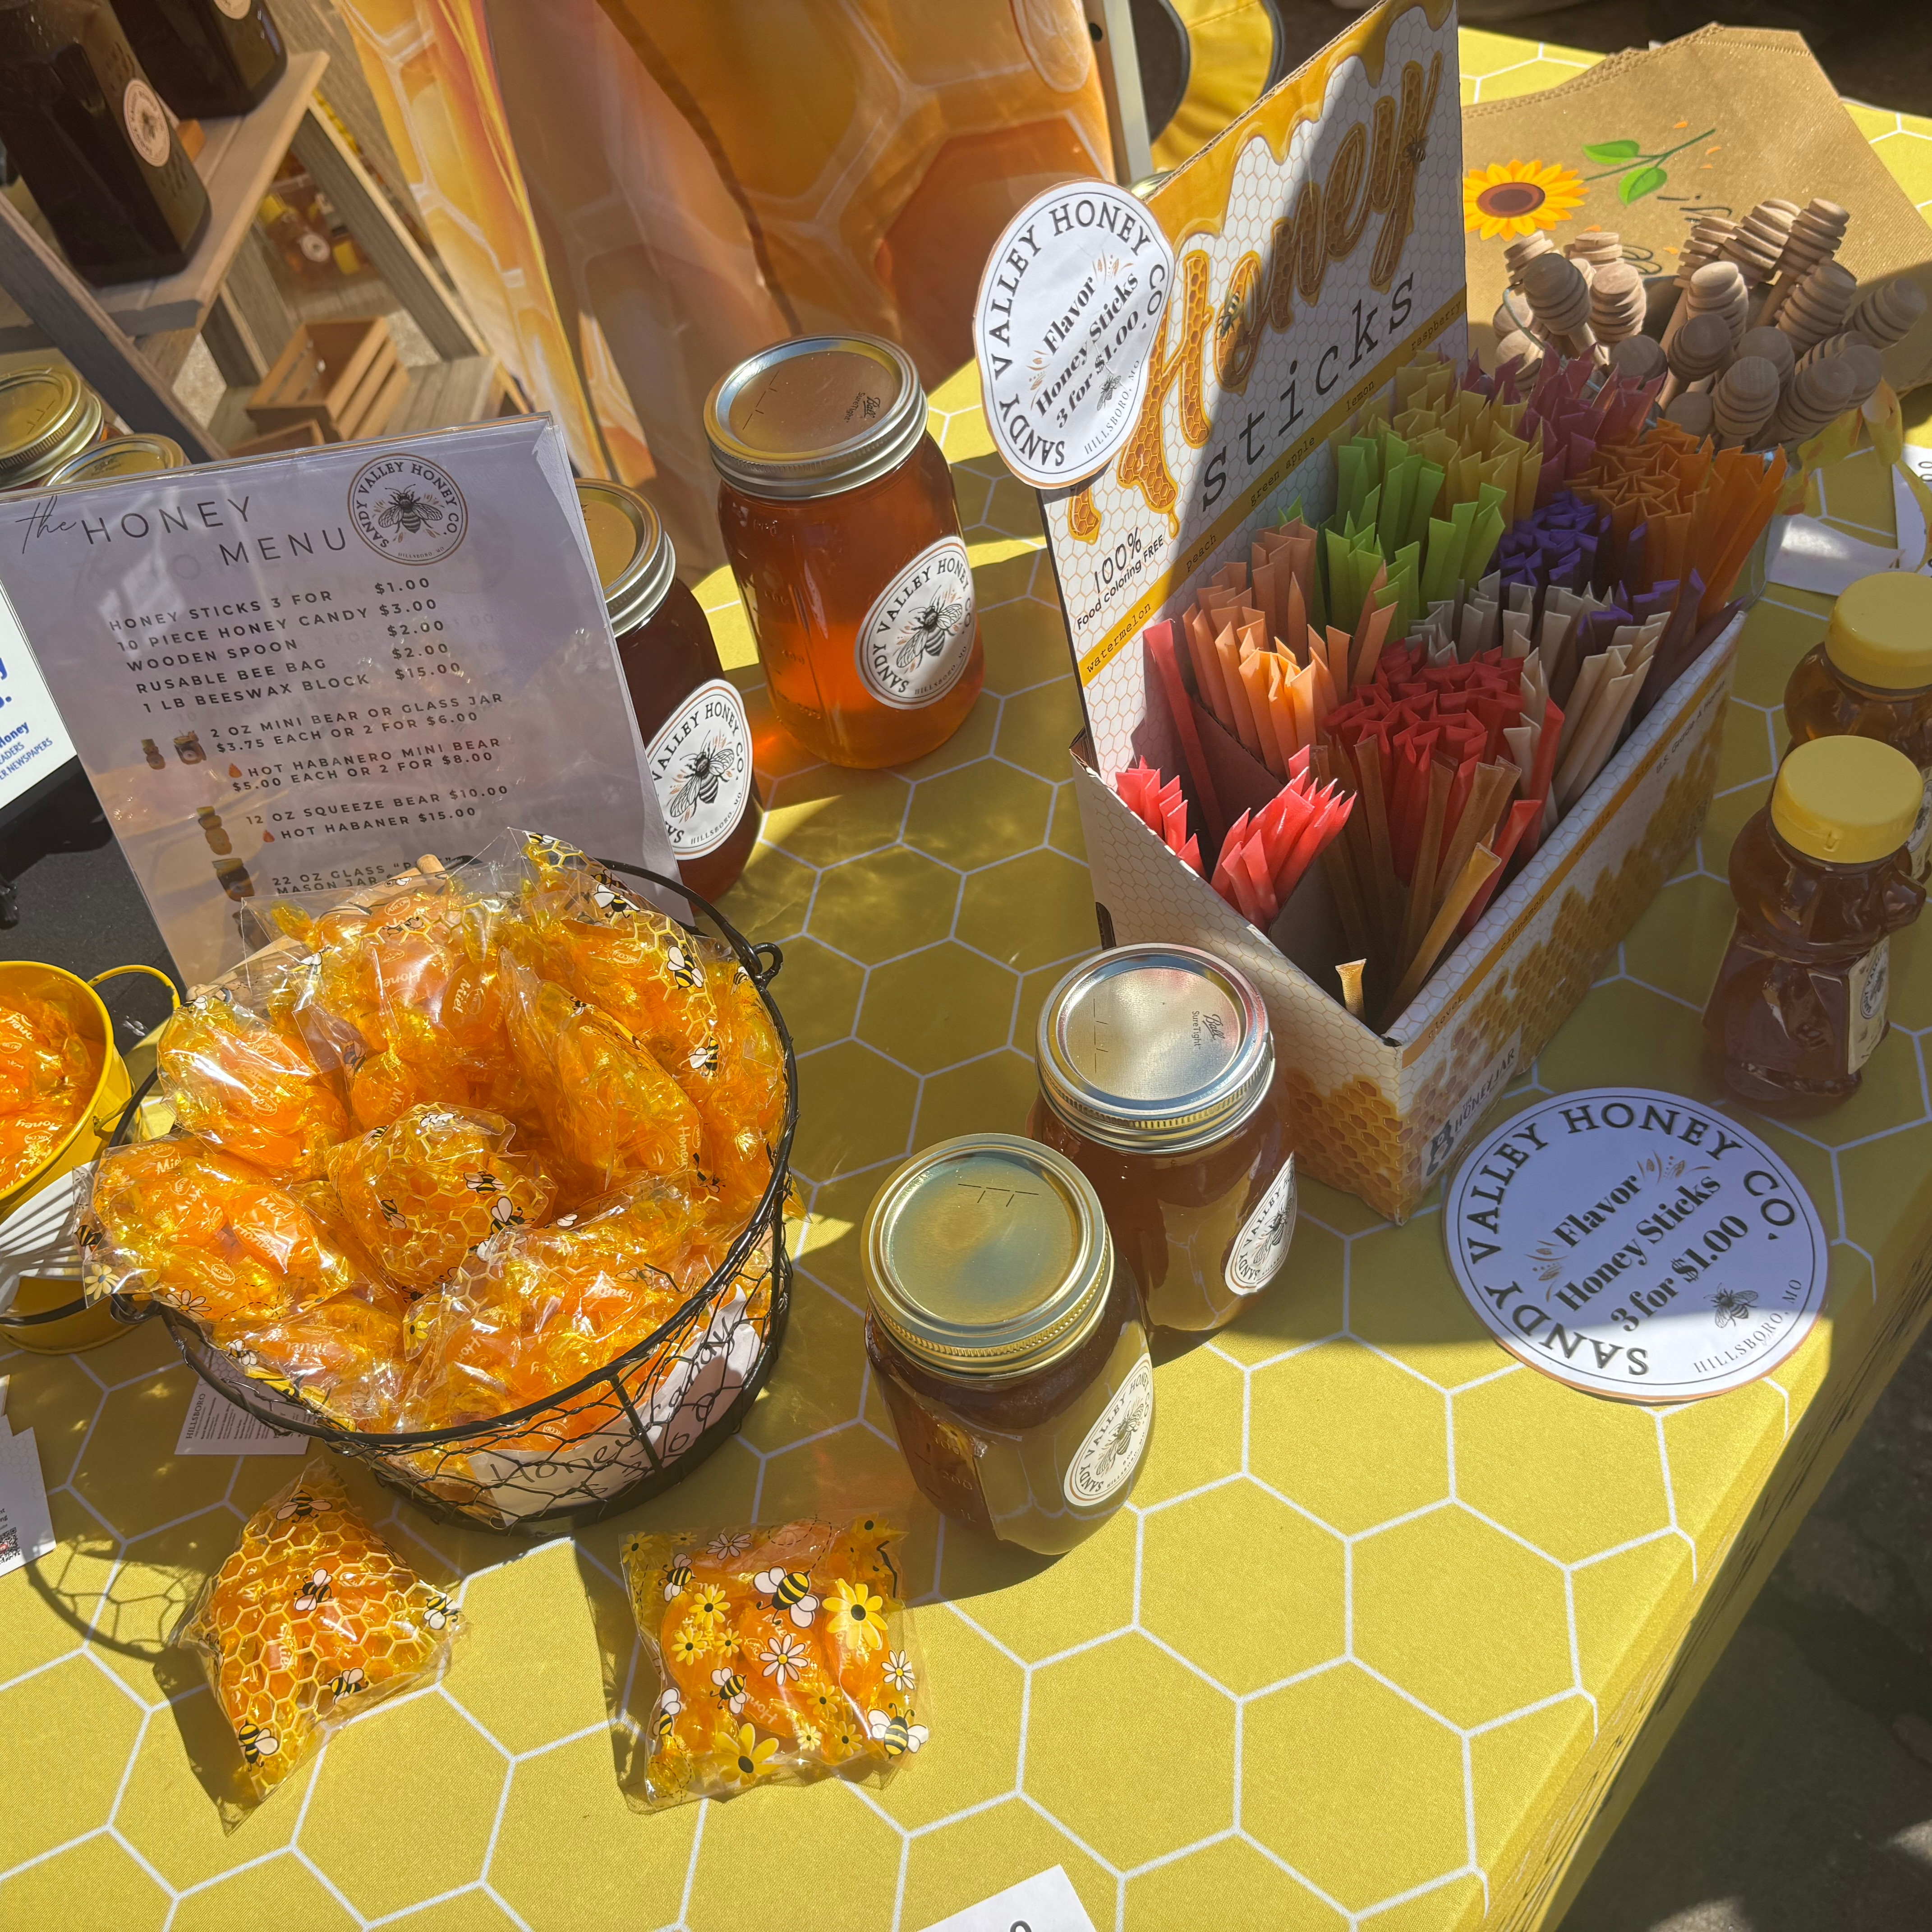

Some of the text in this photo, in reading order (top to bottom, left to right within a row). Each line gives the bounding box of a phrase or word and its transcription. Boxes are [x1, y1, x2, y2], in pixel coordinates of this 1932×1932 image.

[1049, 199, 1151, 257] HONEY
[989, 224, 1042, 381] VALLEY
[1042, 276, 1096, 356] Flavor
[1067, 51, 1445, 543] Honey
[1035, 271, 1139, 417] Honey Sticks
[1410, 300, 1462, 352] raspberry
[1056, 310, 1139, 428] 3 for $1.00
[1128, 359, 1141, 381] MO
[1202, 272, 1416, 512] sticks
[863, 396, 881, 419] Ball
[1345, 380, 1375, 412] lemon
[999, 393, 1065, 467] SANDY
[358, 462, 404, 494] VALLEY
[411, 463, 458, 506] HONEY
[1250, 436, 1316, 506] green apple
[15, 496, 251, 554] the HONEY
[220, 527, 346, 566] MENU
[357, 500, 390, 548] SANDY
[937, 557, 969, 592] HONEY
[1094, 527, 1141, 593] 100%
[1187, 534, 1217, 573] peach
[110, 577, 430, 632] HONEY STICKS 3 FOR $1.00
[877, 566, 931, 634] VALLEY
[1076, 534, 1164, 630] Food coloring FREE
[117, 599, 436, 652] 10 PIECE HONEY CANDY $3.00
[127, 620, 444, 672] WOODEN SPOON $2.00
[1086, 602, 1151, 673] watermelon
[136, 643, 448, 694] RUSABLE BEE BAG $2.00
[143, 662, 460, 713] 1 LB BEESWAX BLOCK $15.00
[873, 644, 910, 693] SANDY
[211, 694, 502, 737] 2 OZ MINI BEAR OR GLASS JAR
[216, 712, 477, 753] $3.75 EACH OR 2 FOR $6.00
[7, 737, 53, 773] NEWSPAPERS
[248, 738, 500, 777] HOT HABANERO MINI BEAR
[654, 711, 699, 782] VALLEY
[705, 701, 739, 736] HONEY
[232, 752, 492, 792] $5.00 EACH OR 2 FOR $8.00
[246, 786, 508, 825] 12 OZ SQUEEZE BEAR $10.00
[281, 807, 476, 839] HOT HABANER $15.00
[272, 865, 385, 886] 22 OZ GLASS
[276, 877, 378, 894] MASON JAR
[1501, 895, 1544, 951] cinnamon
[376, 971, 422, 988] Honey
[1191, 1011, 1201, 1049] SureTight
[1203, 1014, 1225, 1041] Ball
[1428, 994, 1463, 1038] clover
[1559, 1103, 1743, 1160] HONEY
[156, 1153, 182, 1175] Miel
[255, 1196, 294, 1220] Miel
[1243, 1186, 1281, 1248] VALLEY
[1466, 1122, 1548, 1264] VALLEY
[1551, 1174, 1642, 1248] Flavor
[1238, 1252, 1260, 1280] SANDY
[1554, 1176, 1721, 1312] Honey Sticks
[1611, 1214, 1749, 1332] 3 for $1.00
[1782, 1278, 1803, 1304] MO
[1484, 1281, 1650, 1376] SANDY
[1129, 1372, 1149, 1396] HONEY
[186, 1394, 206, 1439] HILLSBORO
[1084, 1394, 1126, 1459] VALLEY
[490, 1427, 644, 1483] Honey
[1080, 1463, 1103, 1492] SANDY
